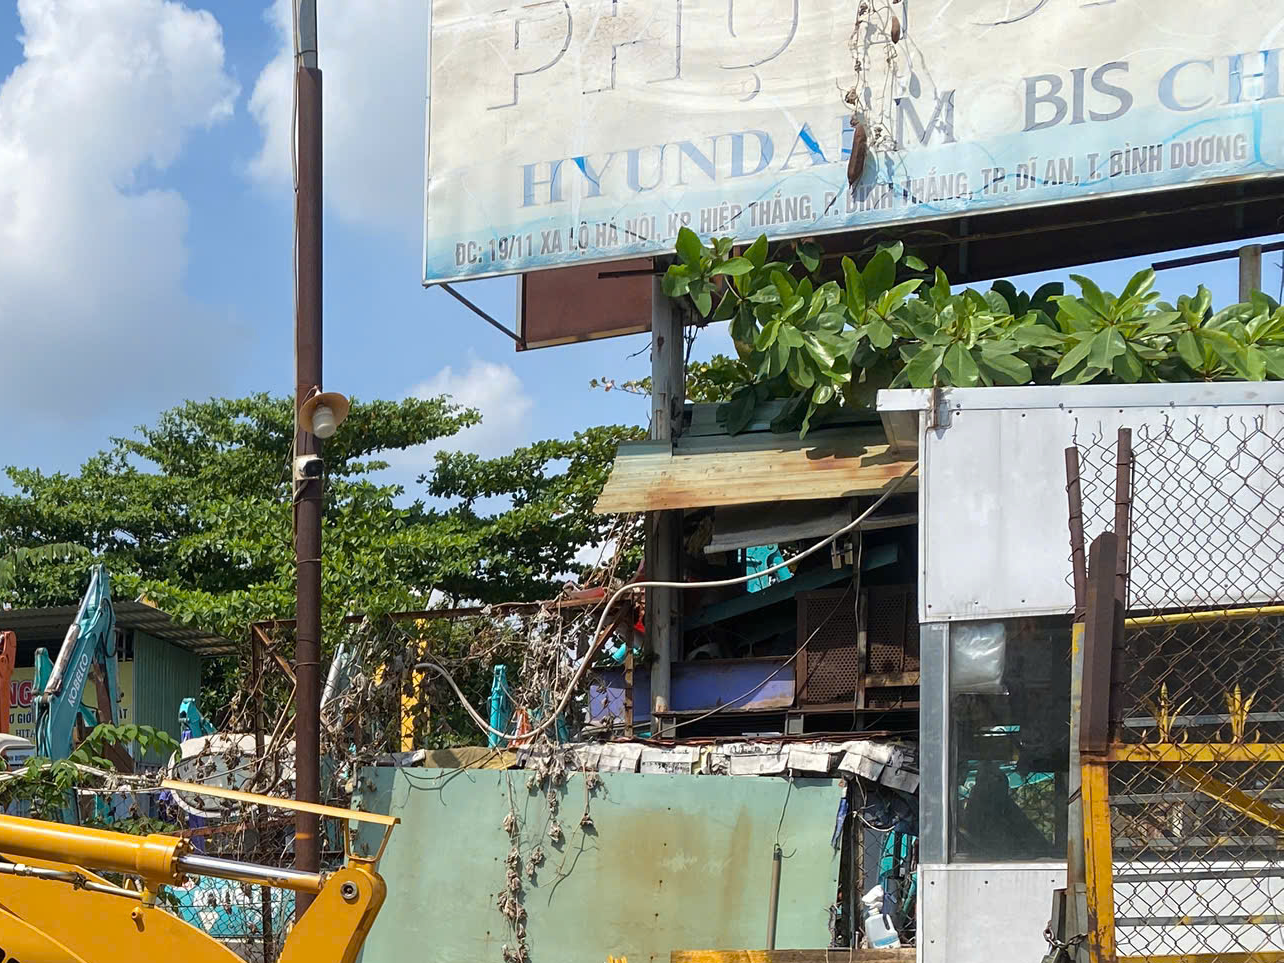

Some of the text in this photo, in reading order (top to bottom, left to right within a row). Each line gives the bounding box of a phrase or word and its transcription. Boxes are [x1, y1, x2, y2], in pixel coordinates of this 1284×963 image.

[455, 241, 483, 266] ĐC:
[489, 234, 533, 261] 19/11
[540, 229, 563, 255] XA
[981, 167, 1009, 195] TP.
[1015, 156, 1038, 190] DĨ
[1043, 157, 1079, 187] AN,
[1087, 152, 1102, 181] T.
[1109, 142, 1163, 177] BÌNH
[1171, 133, 1247, 169] DƯƠNG
[520, 114, 856, 208] HYUNDAI
[68, 654, 88, 707] KOBELCO
